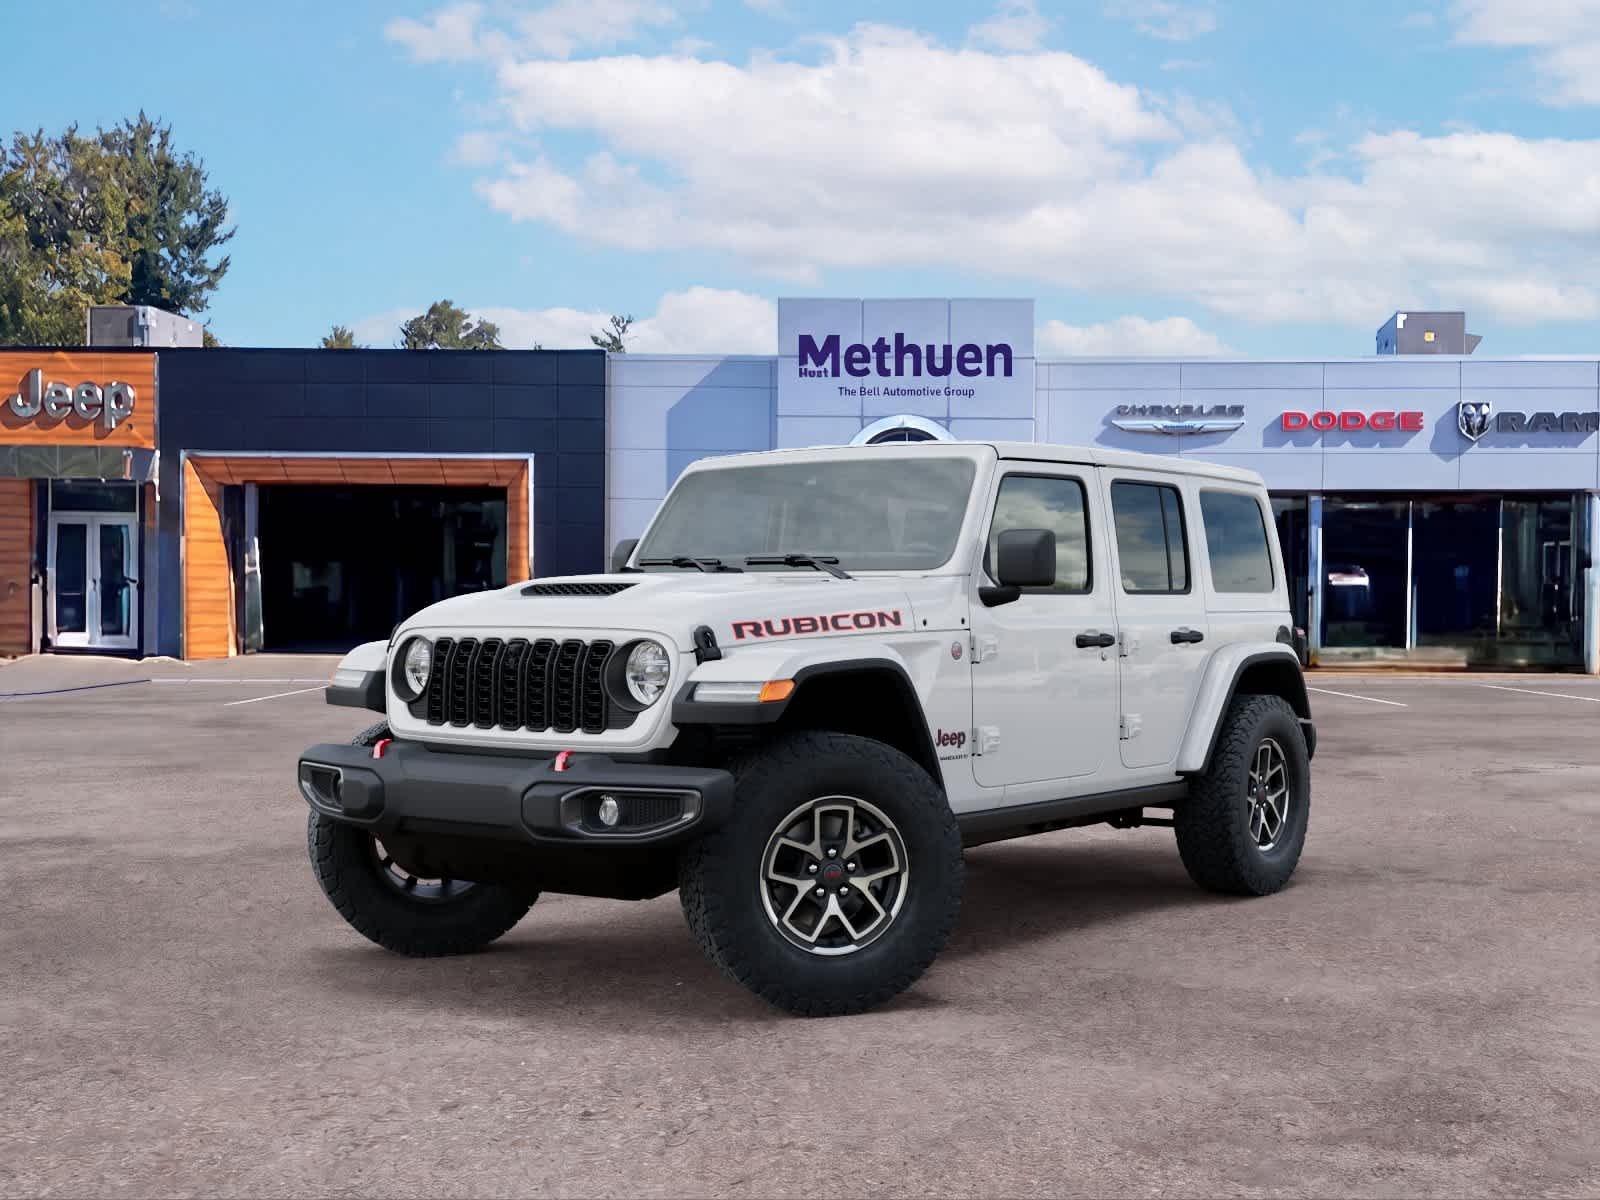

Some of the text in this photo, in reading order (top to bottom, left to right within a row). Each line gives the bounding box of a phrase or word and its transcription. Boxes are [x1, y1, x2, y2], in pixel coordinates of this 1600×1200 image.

[798, 333, 1013, 377] Methuen
[9, 368, 136, 429] Jeep
[838, 386, 975, 398] The Bell Automotive Group
[1282, 411, 1424, 432] DODGE
[1497, 411, 1600, 433] RAM
[732, 610, 902, 640] RUBICON
[936, 728, 966, 748] Jeep
